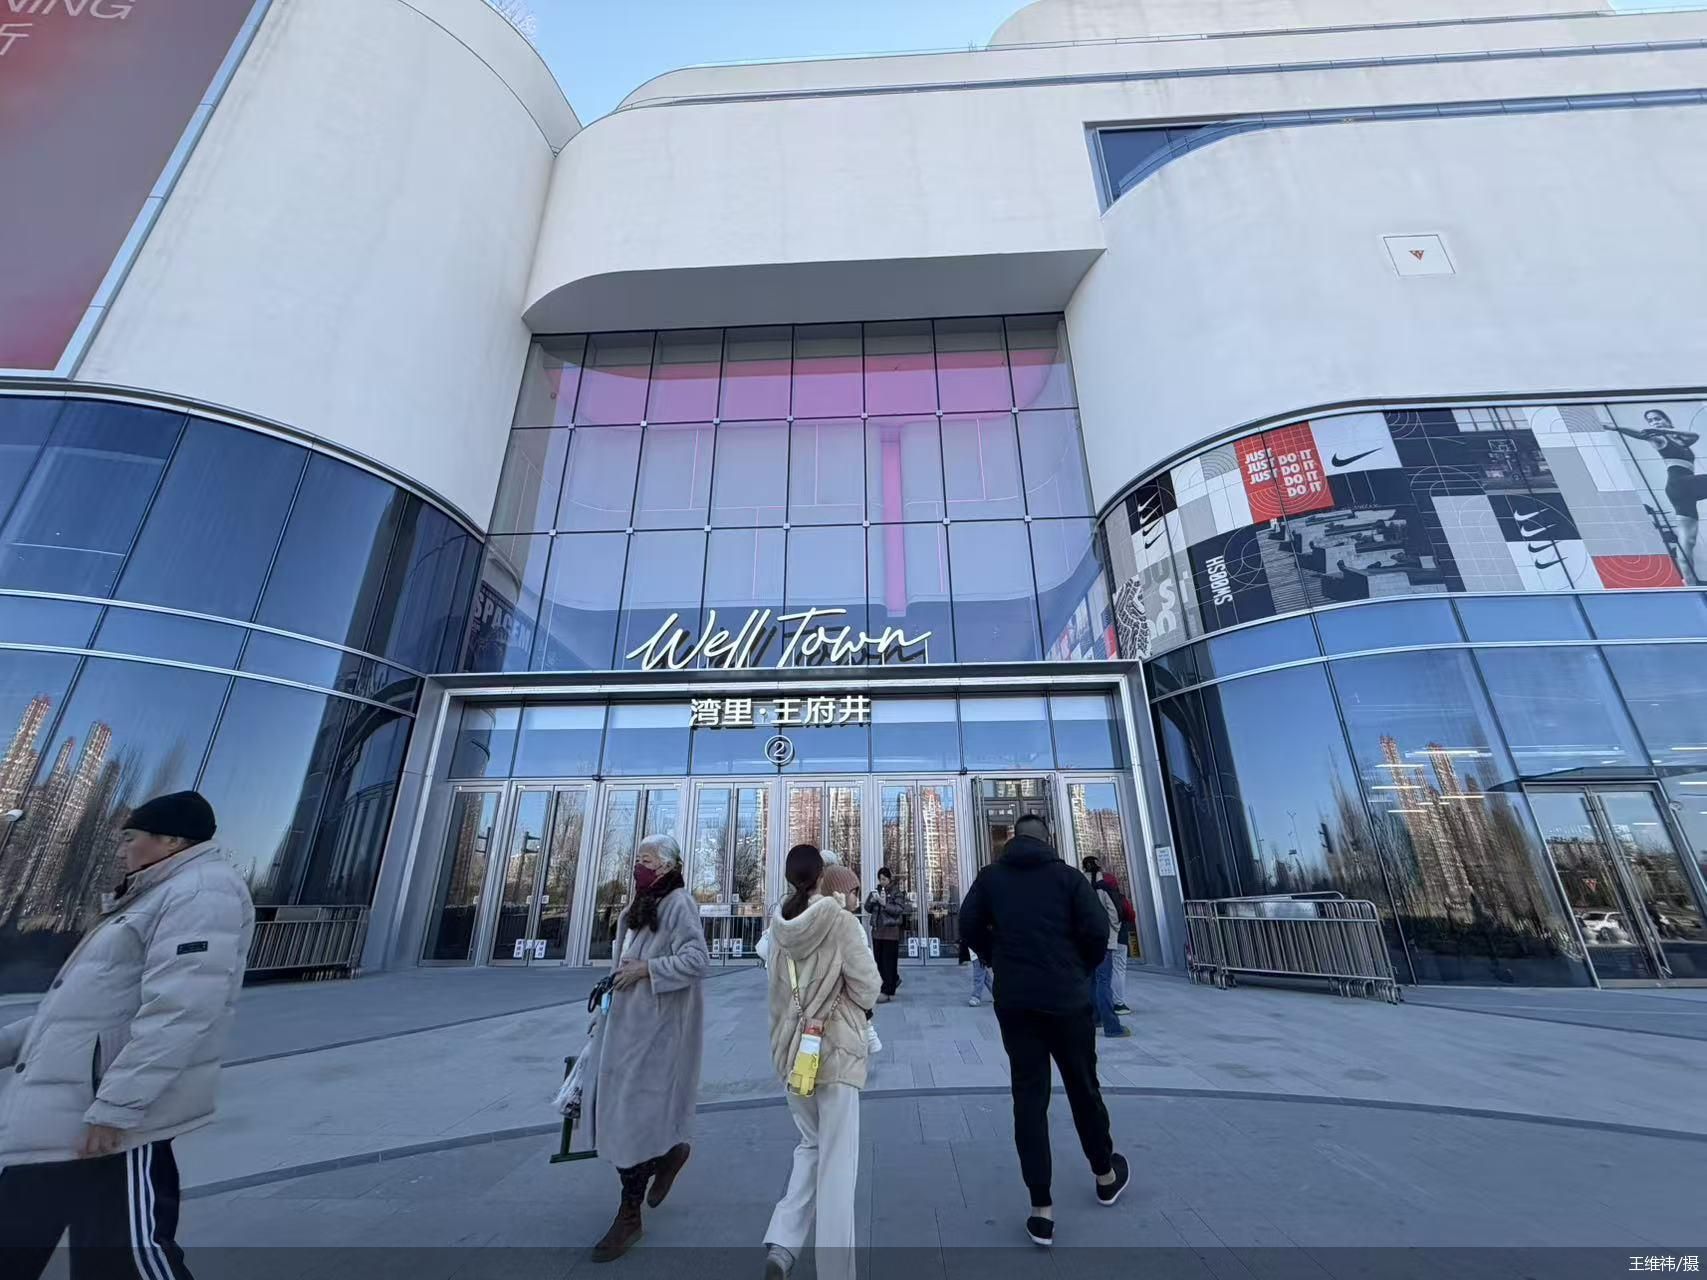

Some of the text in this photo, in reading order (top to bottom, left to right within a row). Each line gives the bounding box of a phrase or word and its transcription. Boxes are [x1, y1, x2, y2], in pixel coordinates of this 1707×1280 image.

[1245, 448, 1272, 464] JUST
[1248, 449, 1312, 474] JUST DO IT
[1250, 460, 1315, 485] JUST DO IT
[1284, 470, 1318, 486] DO IT
[1287, 481, 1321, 497] DO IT
[626, 607, 932, 671] Well Town
[689, 696, 871, 727] 湾里·王府井
